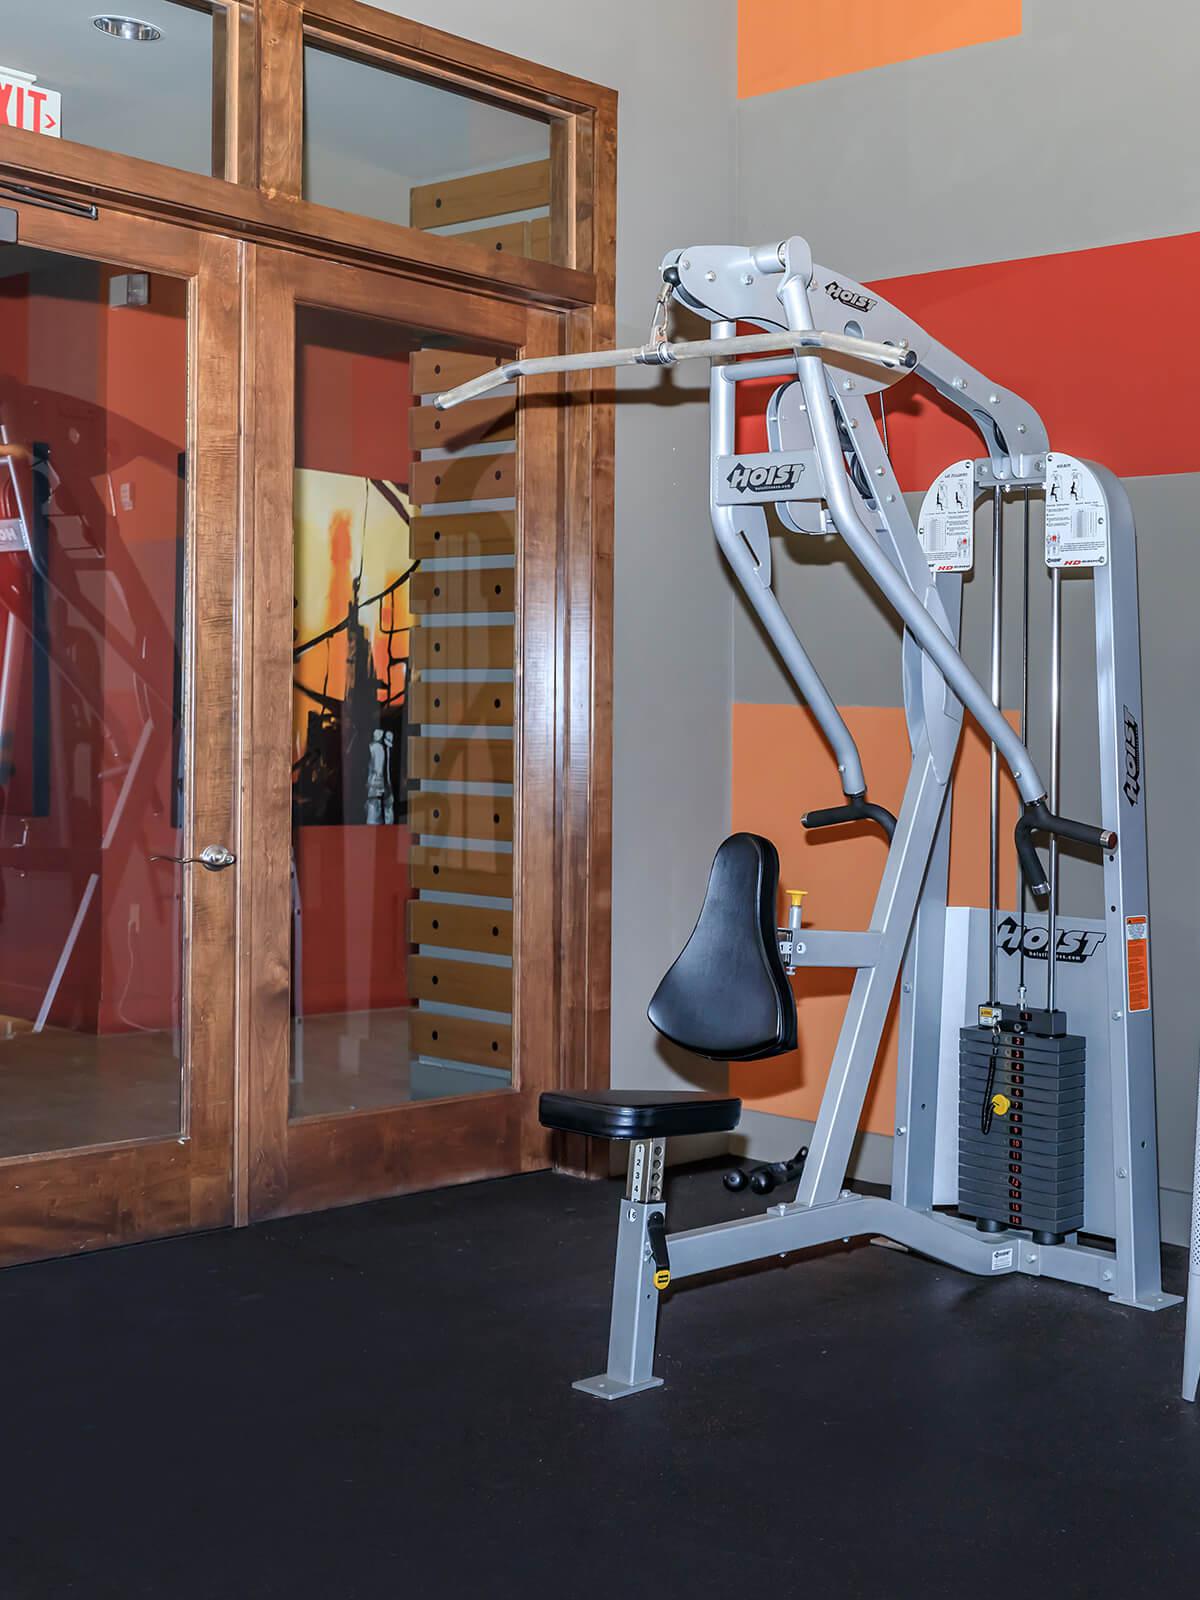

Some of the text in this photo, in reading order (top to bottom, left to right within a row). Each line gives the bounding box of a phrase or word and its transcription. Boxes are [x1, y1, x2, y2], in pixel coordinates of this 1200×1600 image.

[825, 281, 878, 312] HOIST
[728, 463, 805, 489] HOIST
[1123, 704, 1140, 807] HOIST
[996, 917, 1107, 957] HOIST
